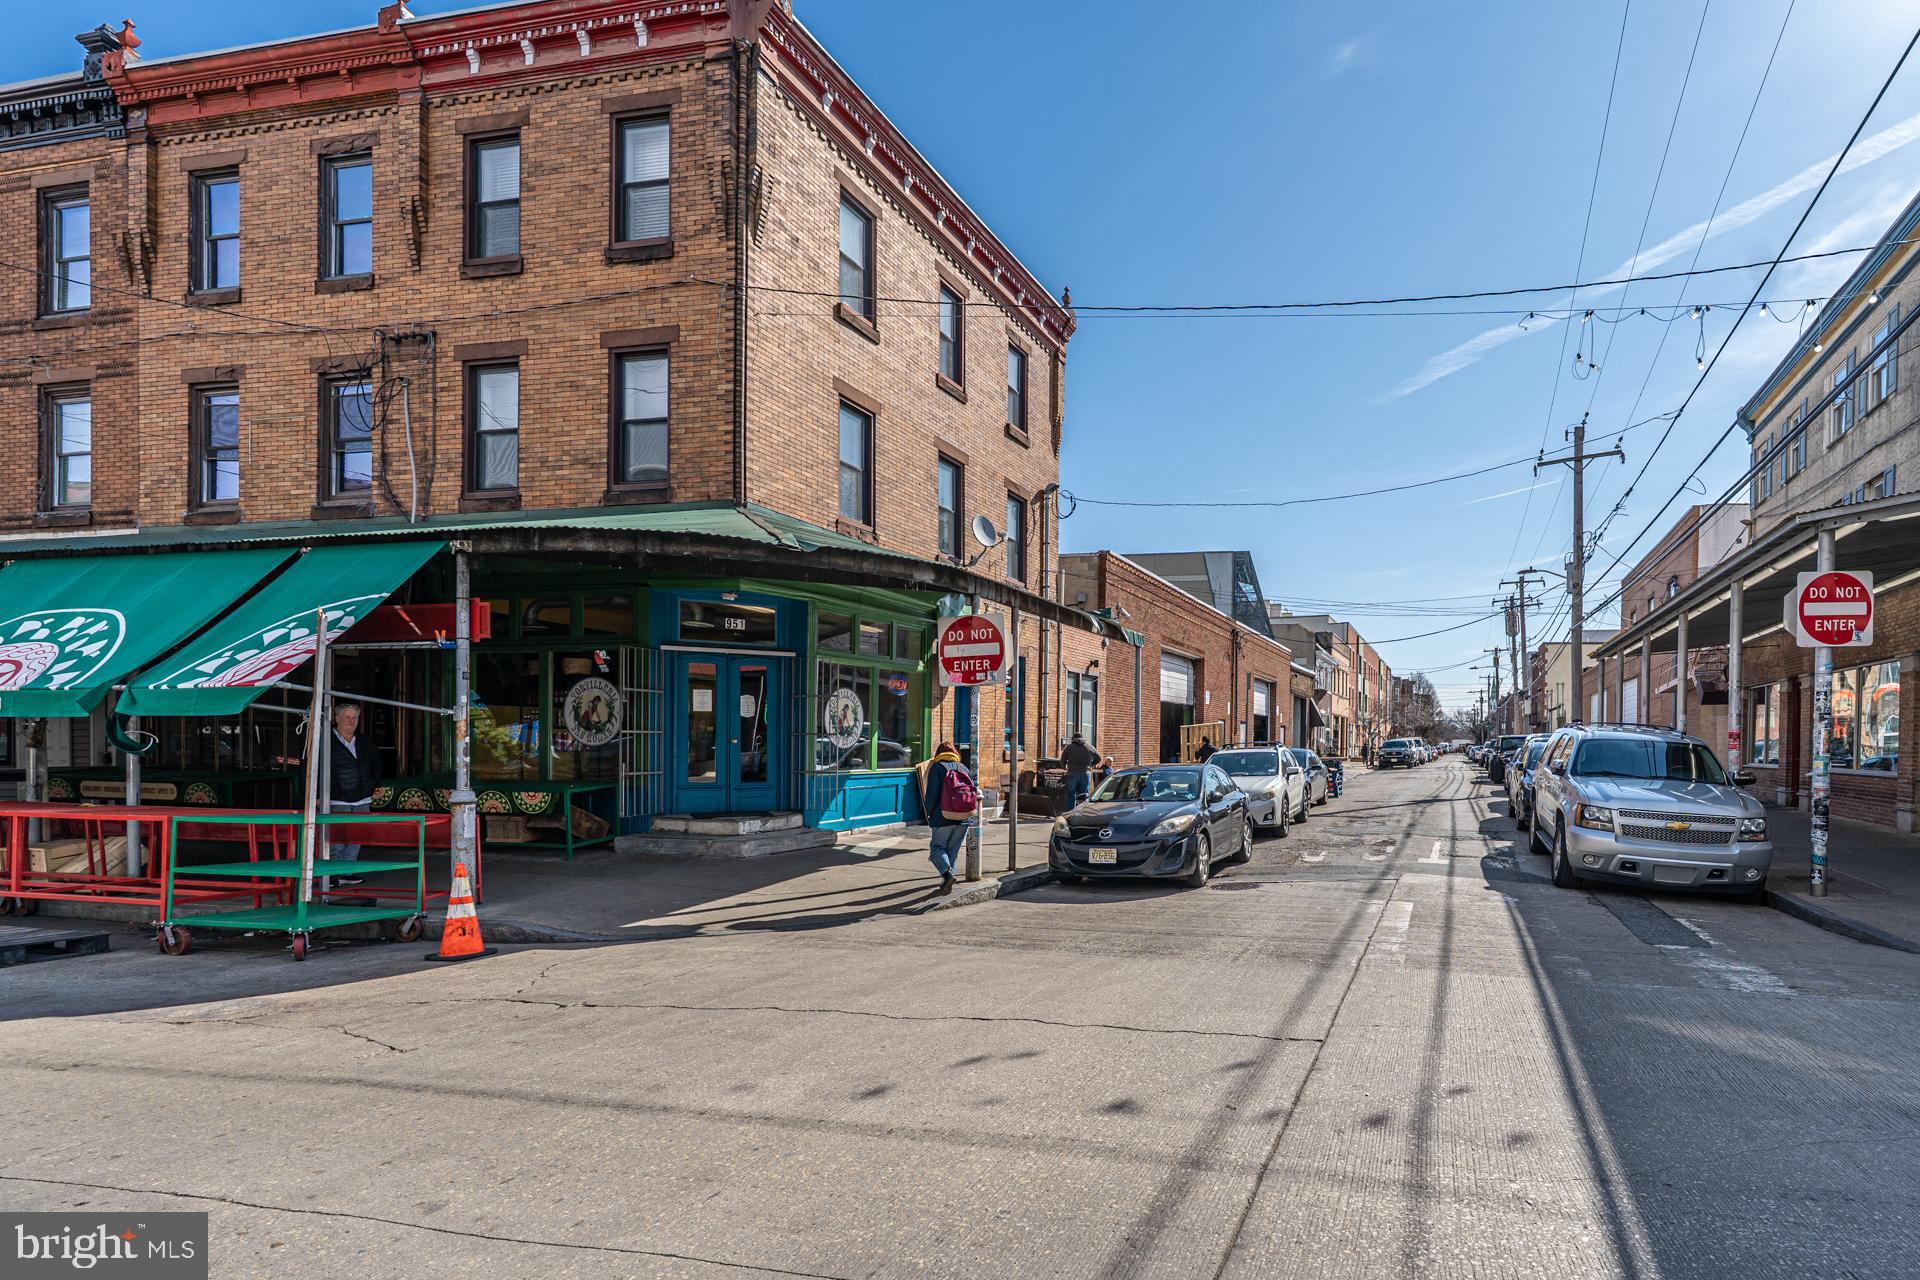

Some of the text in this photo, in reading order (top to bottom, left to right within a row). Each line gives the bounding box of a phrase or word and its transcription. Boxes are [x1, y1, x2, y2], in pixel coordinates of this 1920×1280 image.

[1810, 587, 1861, 598] DO NOT
[727, 619, 744, 629] 951
[1815, 619, 1856, 631] ENTER
[948, 628, 994, 642] DO NOT
[953, 659, 991, 672] ENTER
[570, 680, 619, 705] TORTILLERIA
